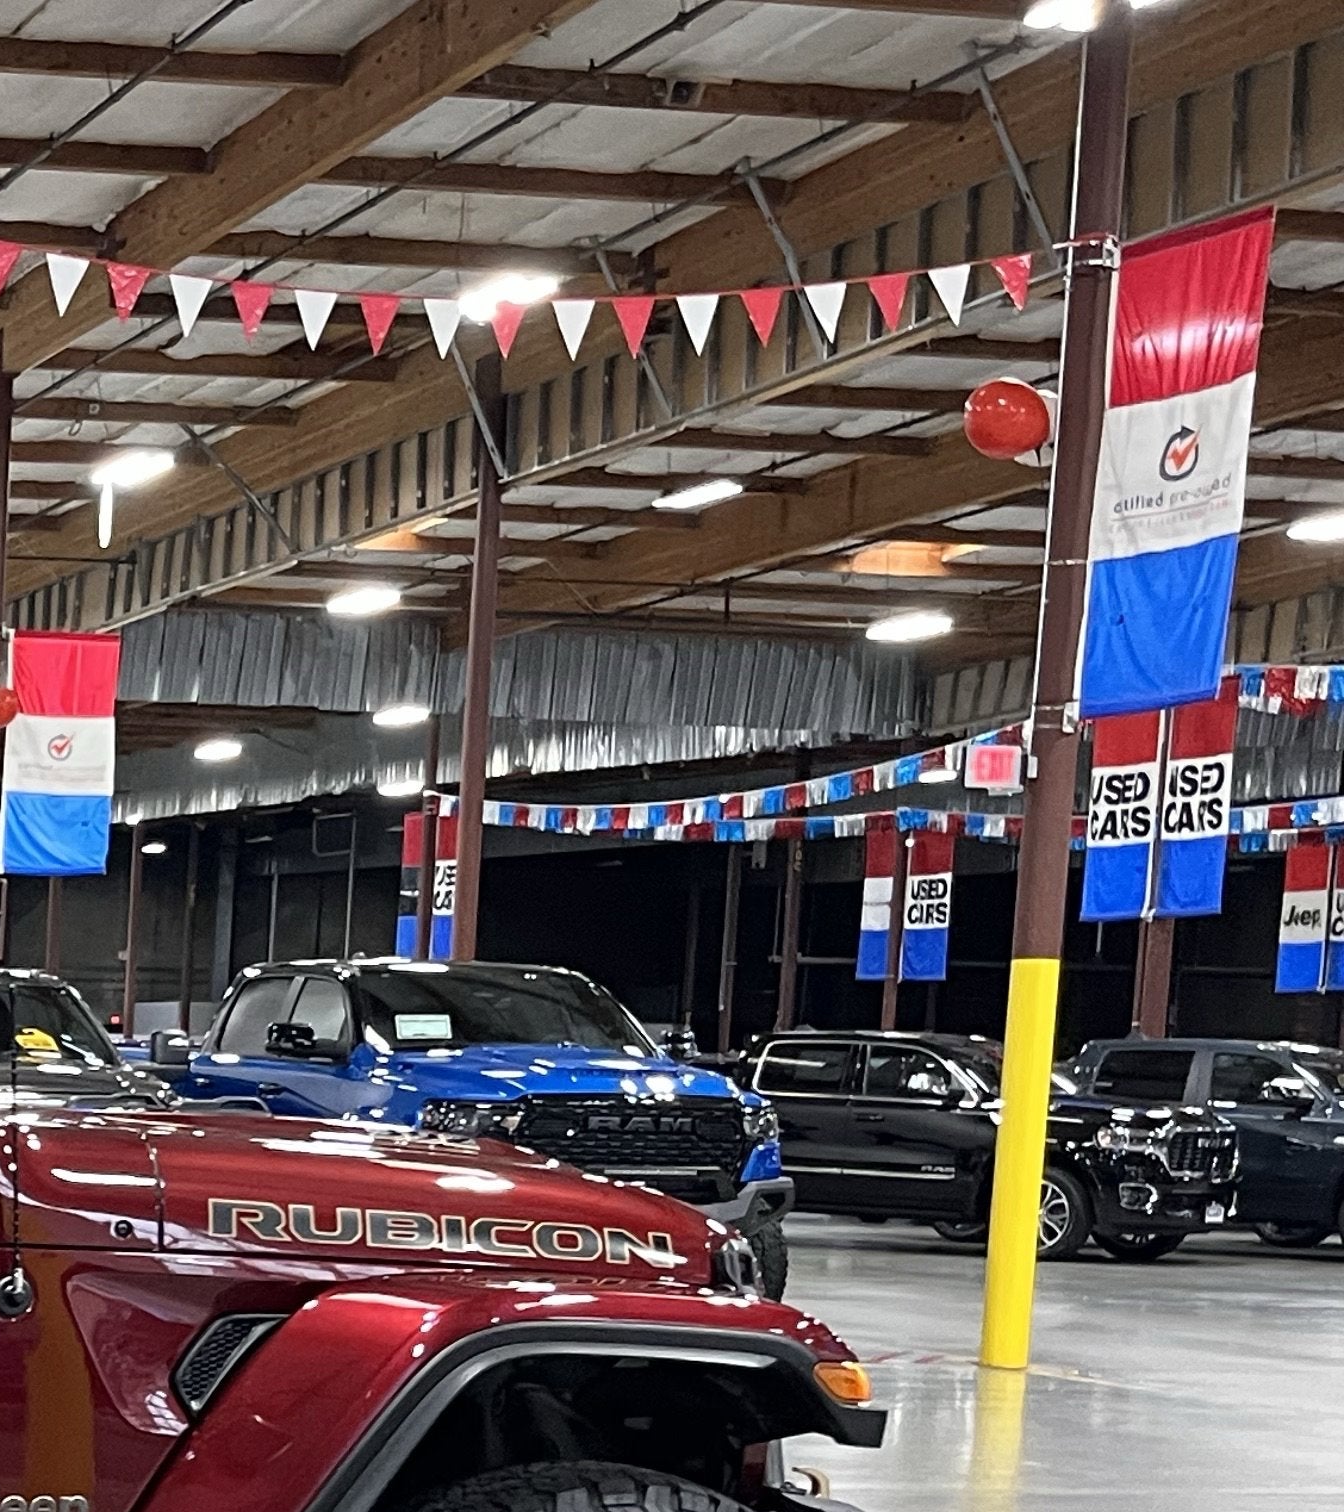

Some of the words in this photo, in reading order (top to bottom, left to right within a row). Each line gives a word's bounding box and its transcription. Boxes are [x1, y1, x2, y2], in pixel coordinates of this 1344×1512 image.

[1091, 772, 1150, 805] USED
[1091, 806, 1150, 840] CARS
[1164, 797, 1223, 833] CARS
[911, 878, 948, 900] USED
[588, 1116, 694, 1132] RAM
[208, 1198, 677, 1268] RUBICON
